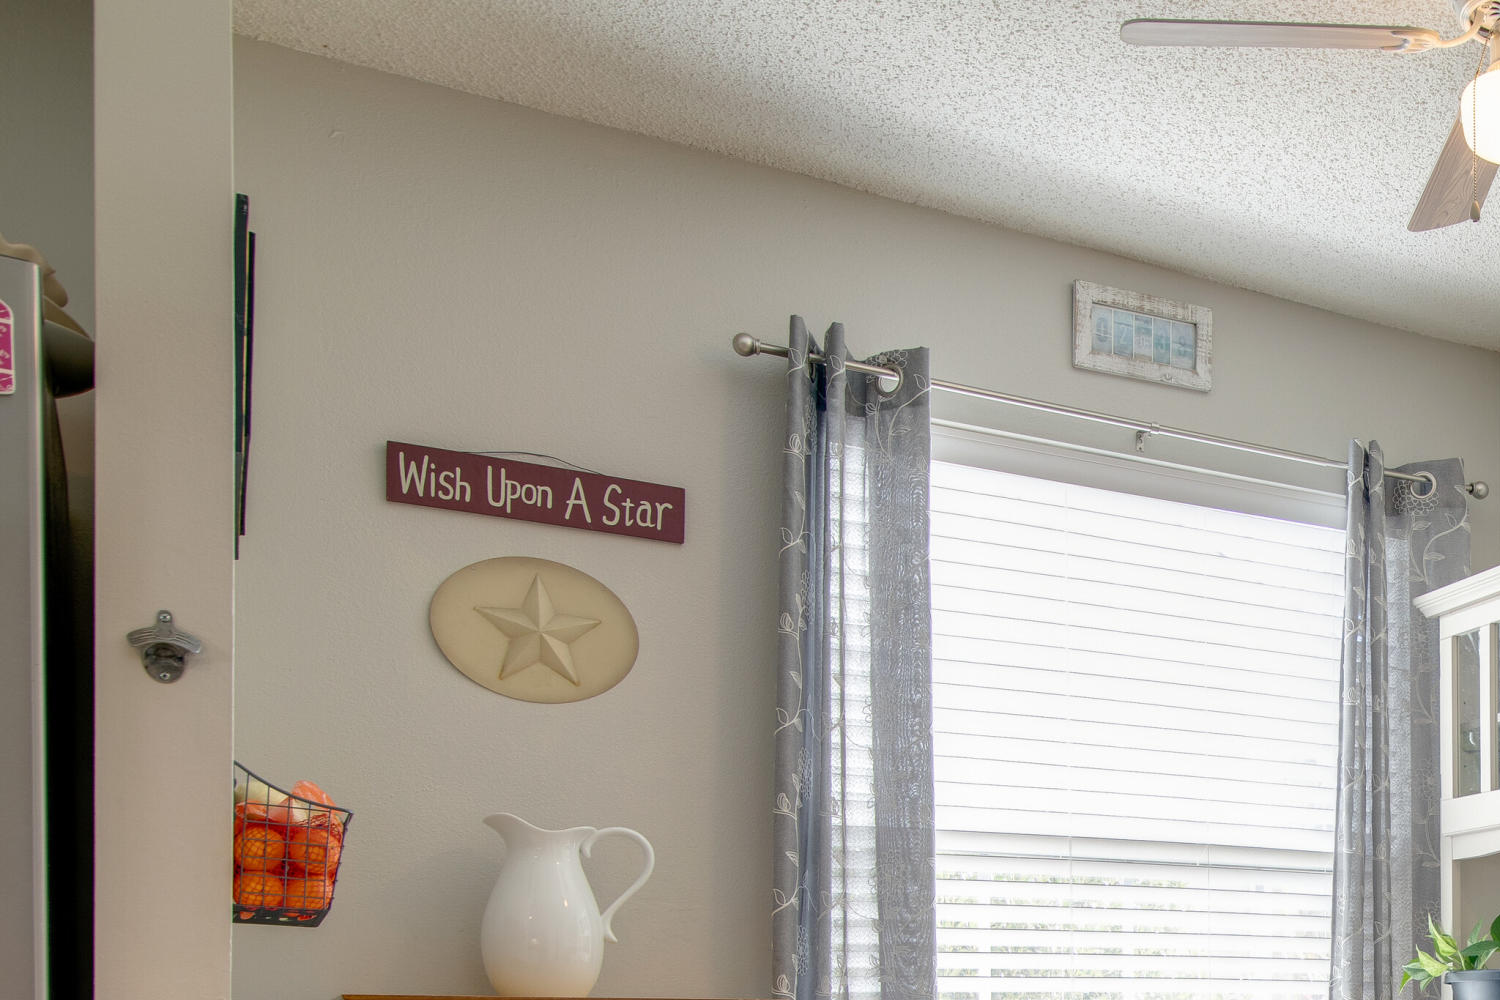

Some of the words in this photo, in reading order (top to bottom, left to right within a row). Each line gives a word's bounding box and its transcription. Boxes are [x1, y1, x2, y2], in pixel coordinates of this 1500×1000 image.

[398, 451, 472, 503] Wish
[487, 465, 553, 514] Upon
[565, 477, 592, 524] A
[602, 484, 673, 531] Star
